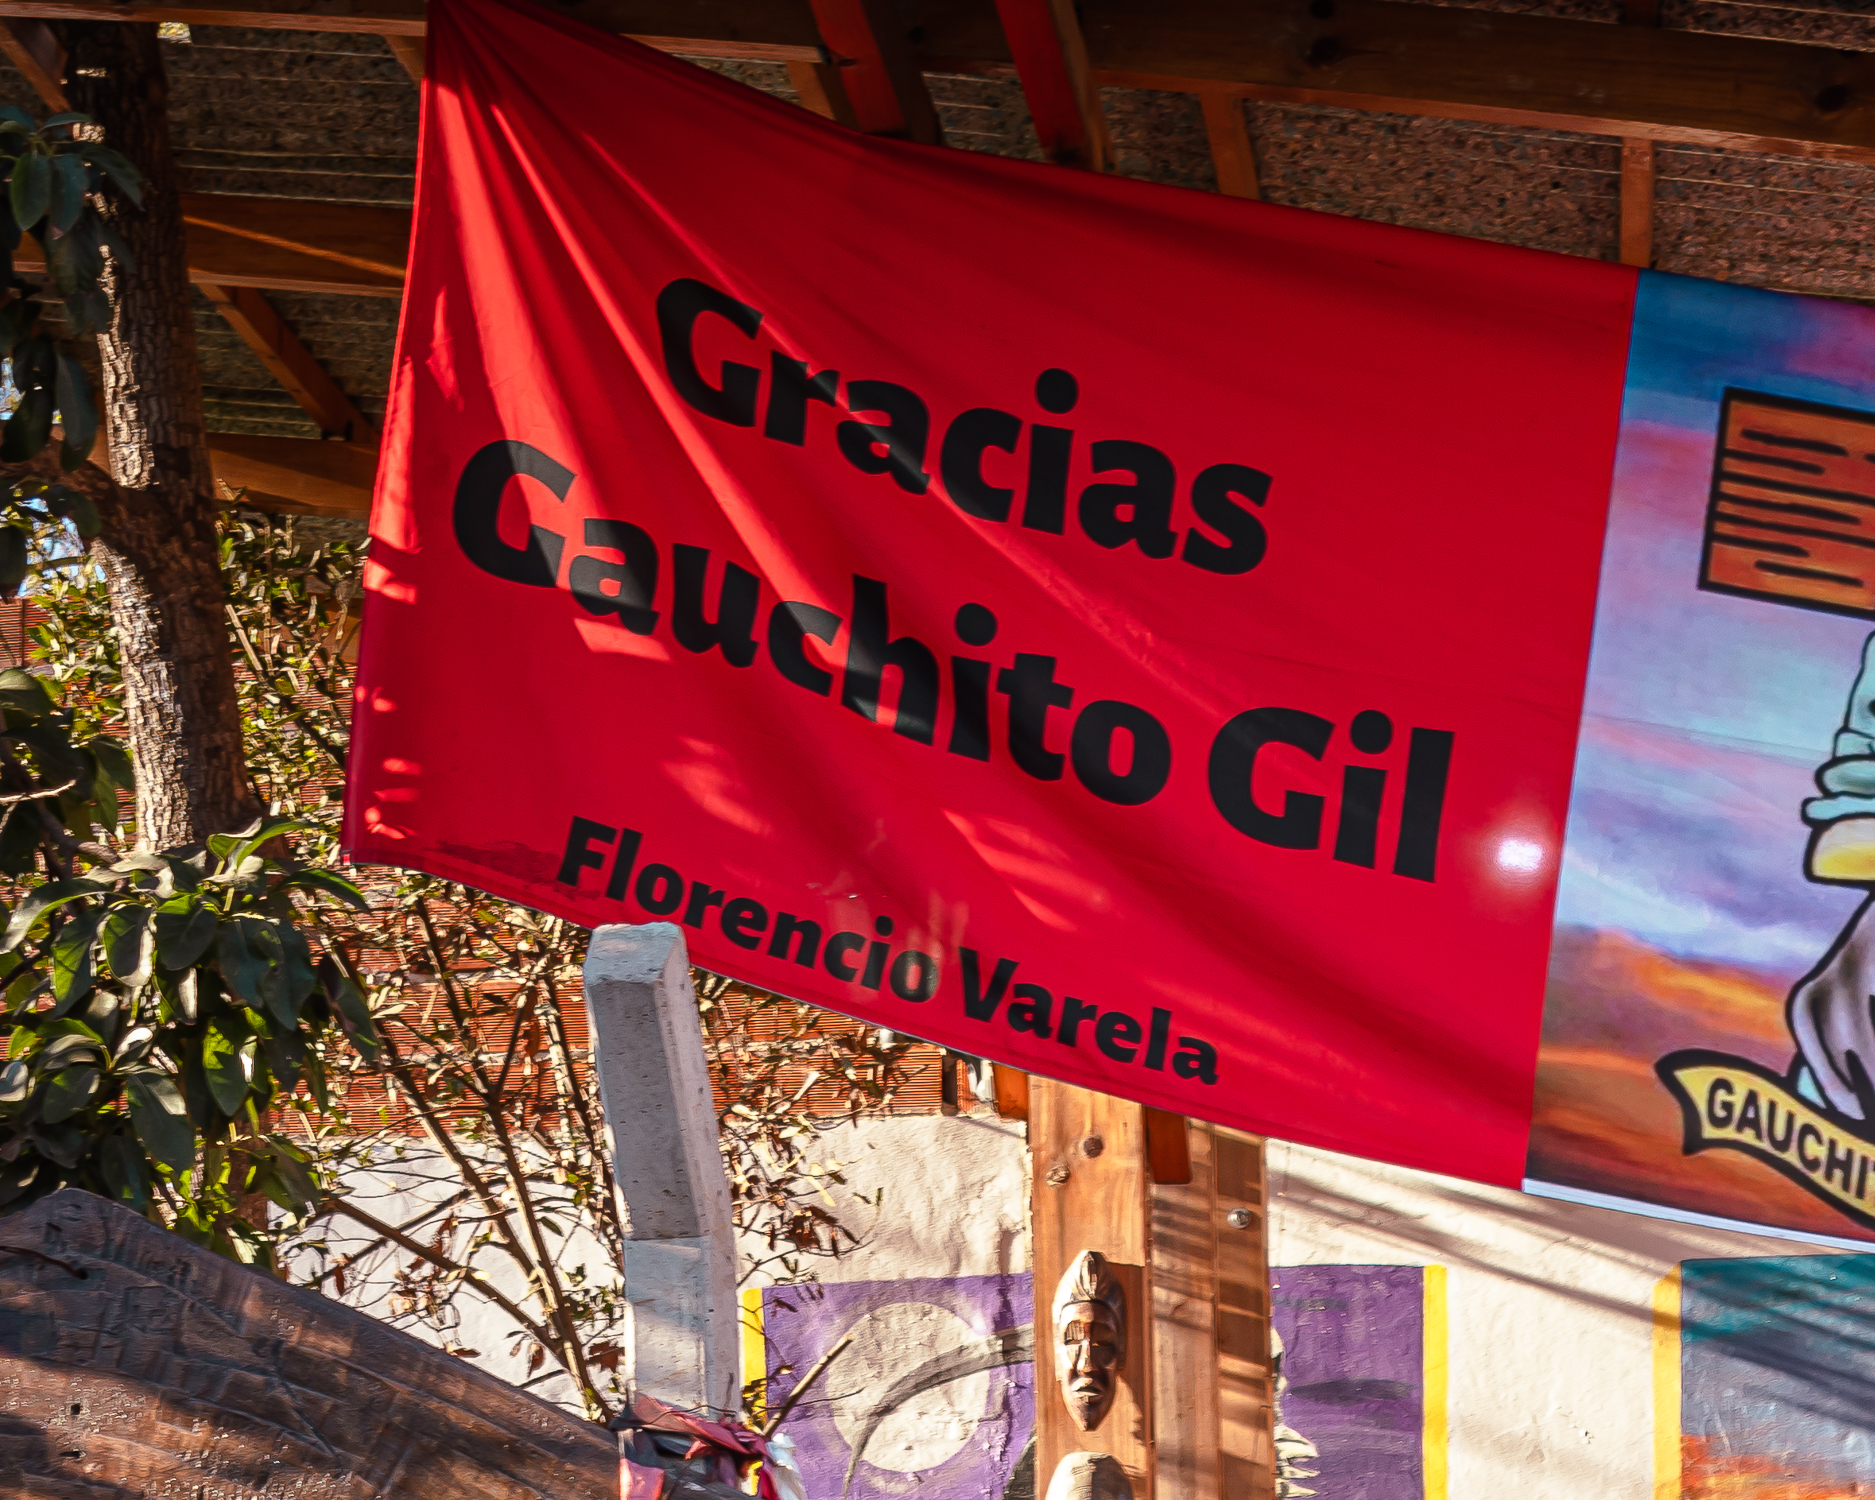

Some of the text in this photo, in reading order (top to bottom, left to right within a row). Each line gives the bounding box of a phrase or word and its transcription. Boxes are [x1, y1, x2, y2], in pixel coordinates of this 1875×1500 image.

[656, 277, 1274, 576] Gracias
[452, 439, 1455, 883] Gauchito Gil
[556, 815, 1219, 1085] Florencio Varela
